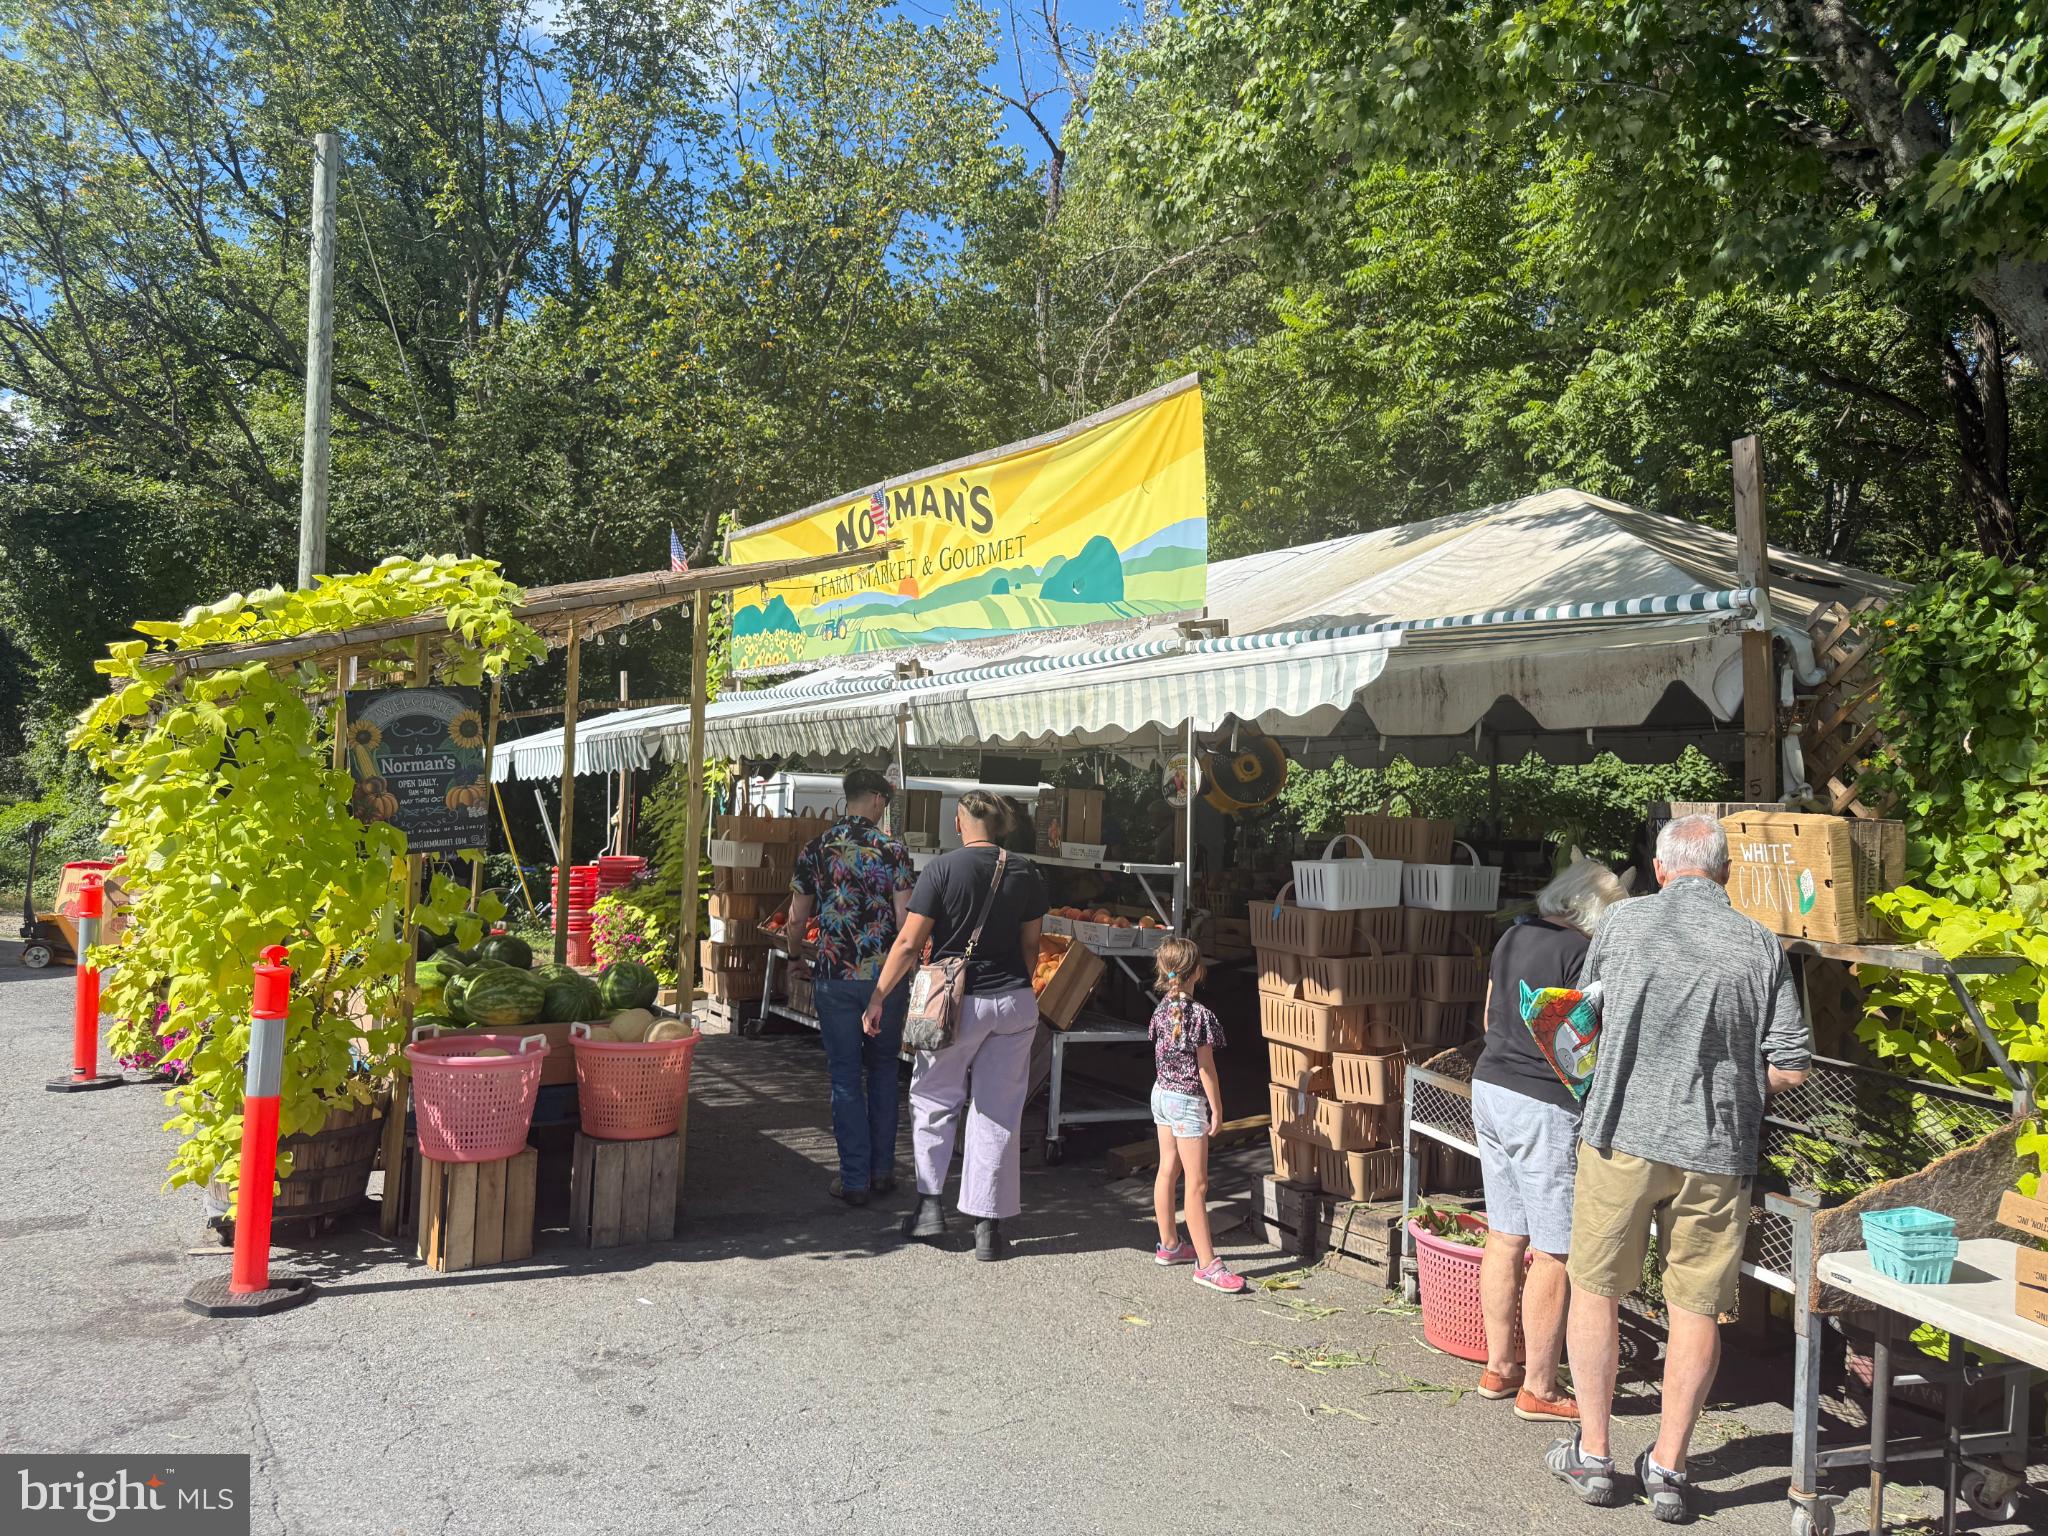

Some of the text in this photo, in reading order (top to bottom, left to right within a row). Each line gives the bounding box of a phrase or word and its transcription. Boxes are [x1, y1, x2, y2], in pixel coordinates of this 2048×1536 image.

[820, 534, 1026, 599] FARM MARKET & GOURMET
[376, 695, 454, 717] WELCOME
[415, 743, 423, 756] to
[381, 755, 456, 775] Norman's
[398, 779, 416, 788] OPEN
[1750, 778, 1762, 797] 5
[1740, 842, 1796, 864] WHITE
[1738, 864, 1793, 913] CORN
[1865, 849, 1877, 912] BAUGHR
[2016, 1214, 2030, 1226] INC.
[2033, 1271, 2048, 1282] INC.
